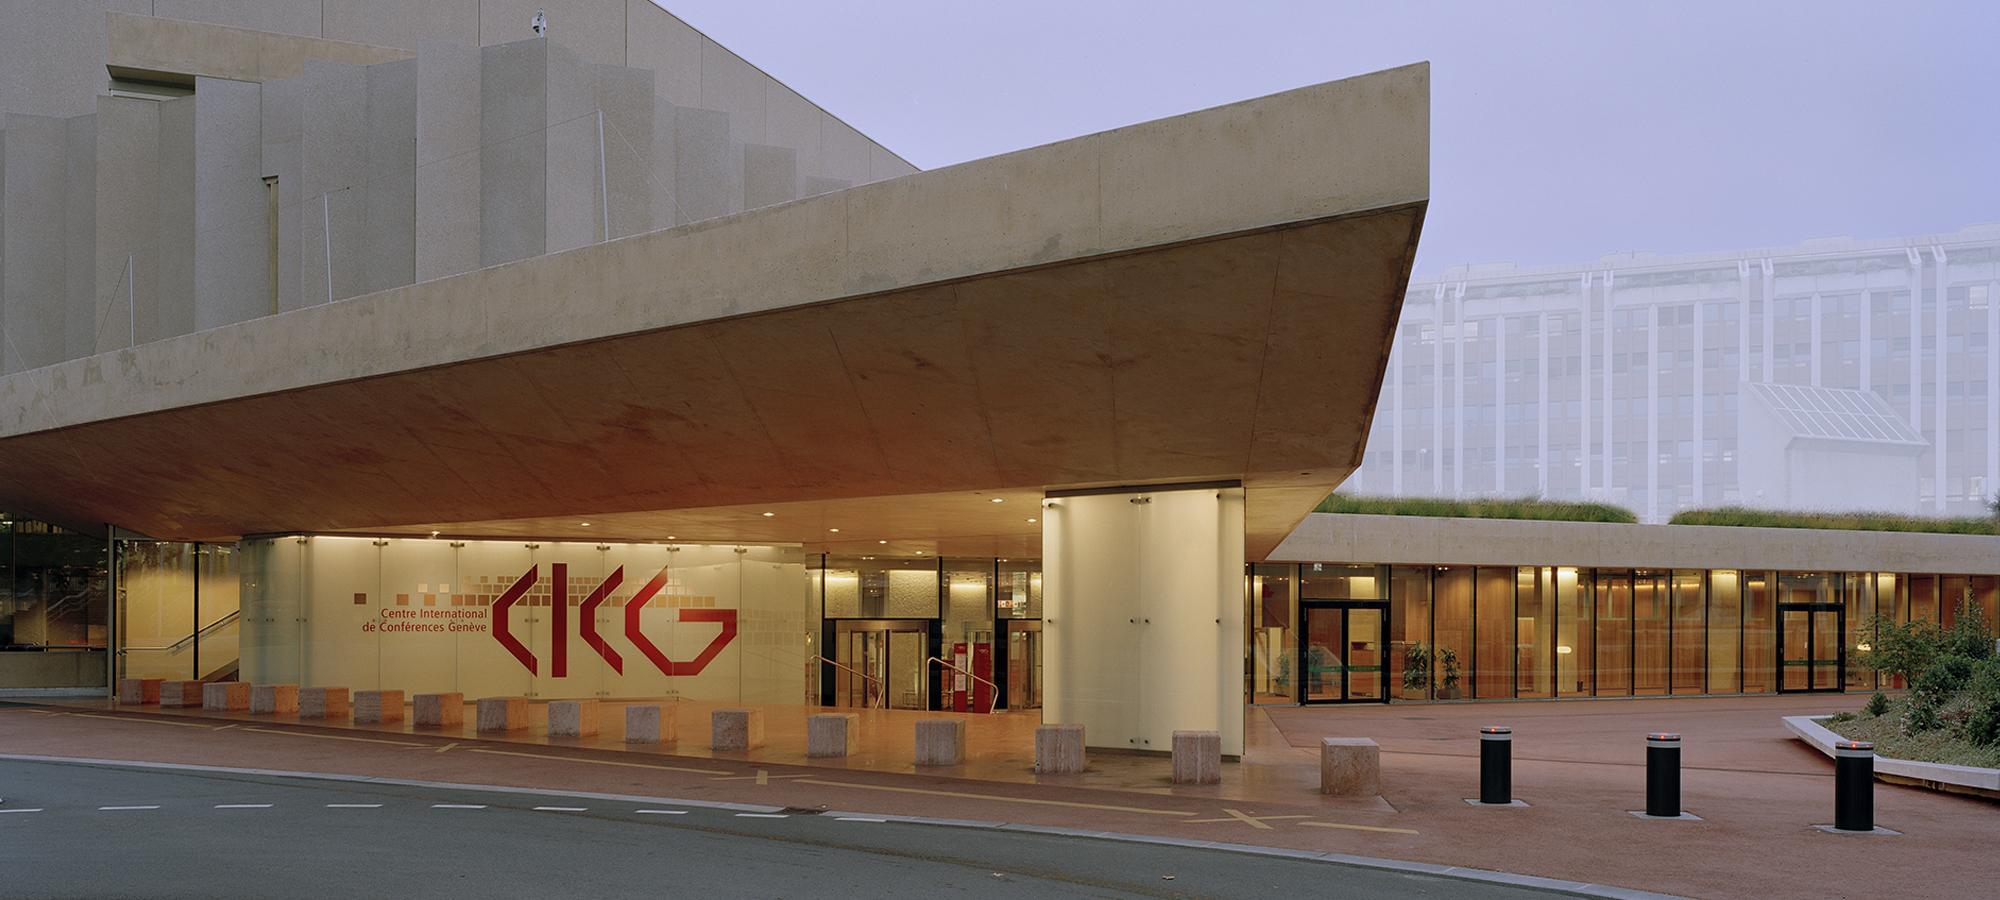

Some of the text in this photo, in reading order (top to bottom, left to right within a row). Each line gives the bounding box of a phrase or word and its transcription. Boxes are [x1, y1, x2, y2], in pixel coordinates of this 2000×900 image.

[381, 608, 488, 619] Centre International
[362, 621, 487, 632] de Conférences Genève
